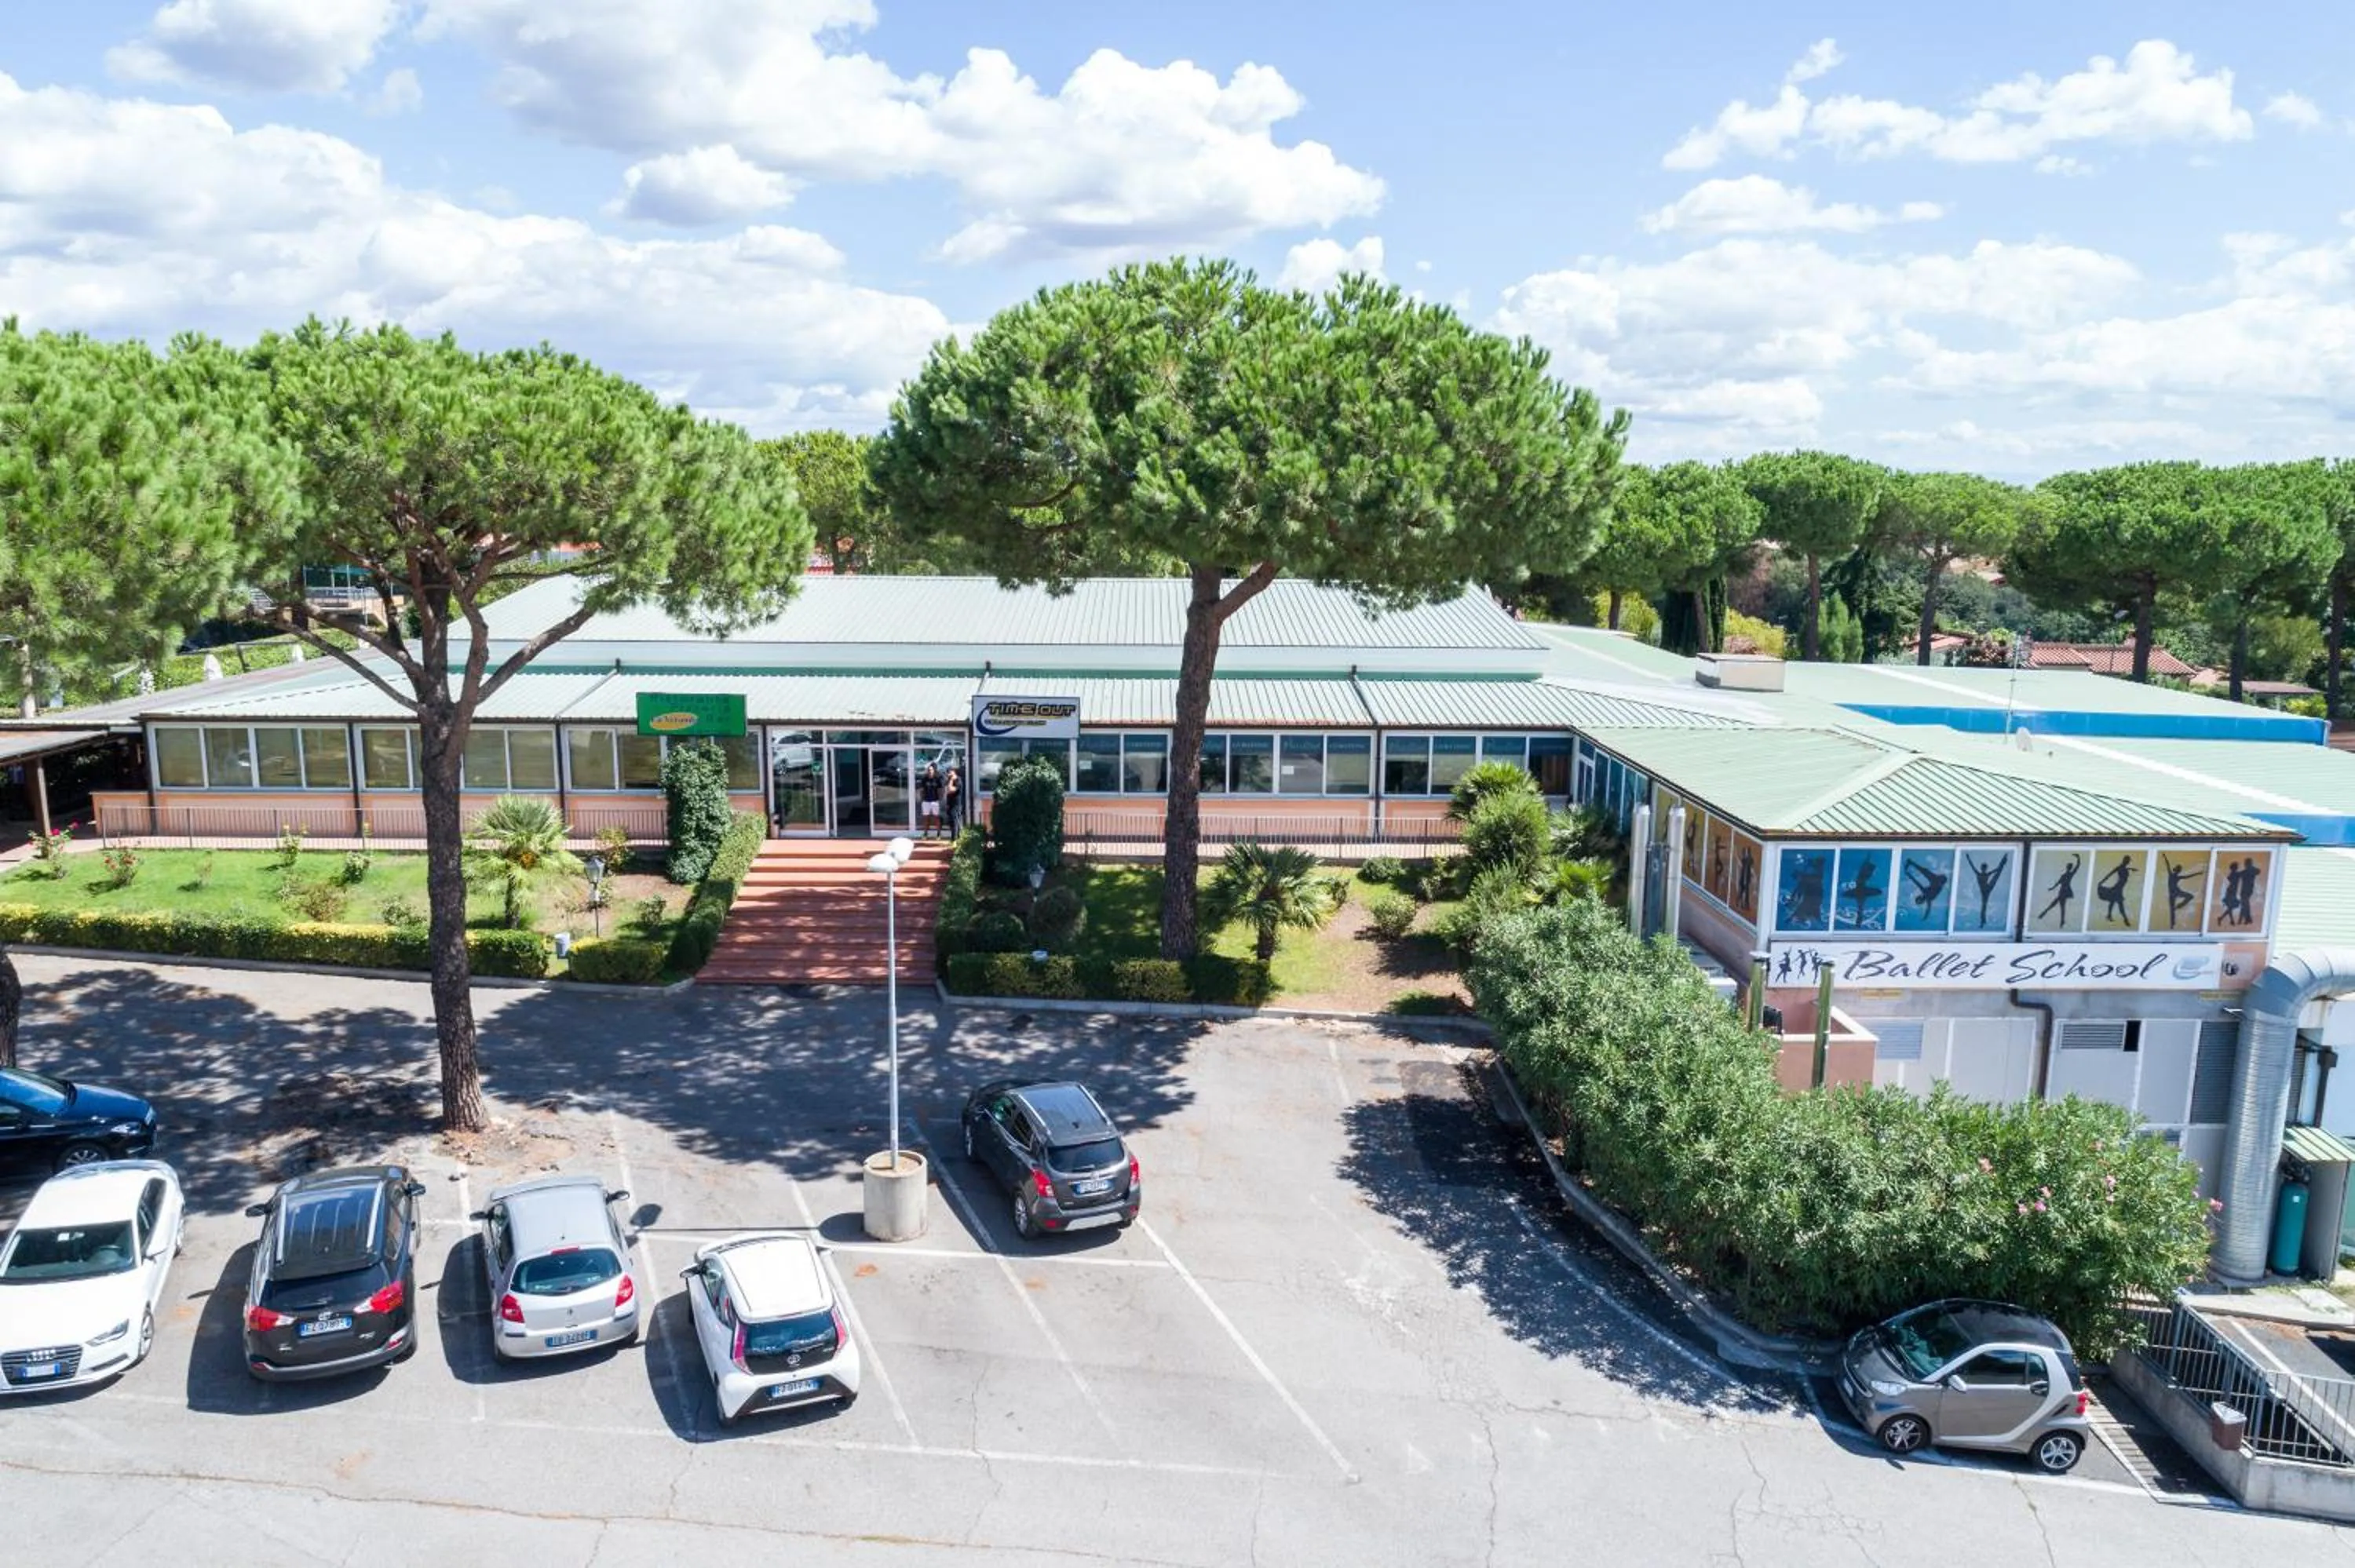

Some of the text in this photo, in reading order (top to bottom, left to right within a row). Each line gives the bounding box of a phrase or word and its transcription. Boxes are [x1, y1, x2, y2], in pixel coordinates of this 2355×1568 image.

[987, 702, 1076, 717] TIME OUT
[1842, 949, 2168, 983] Ballet School
